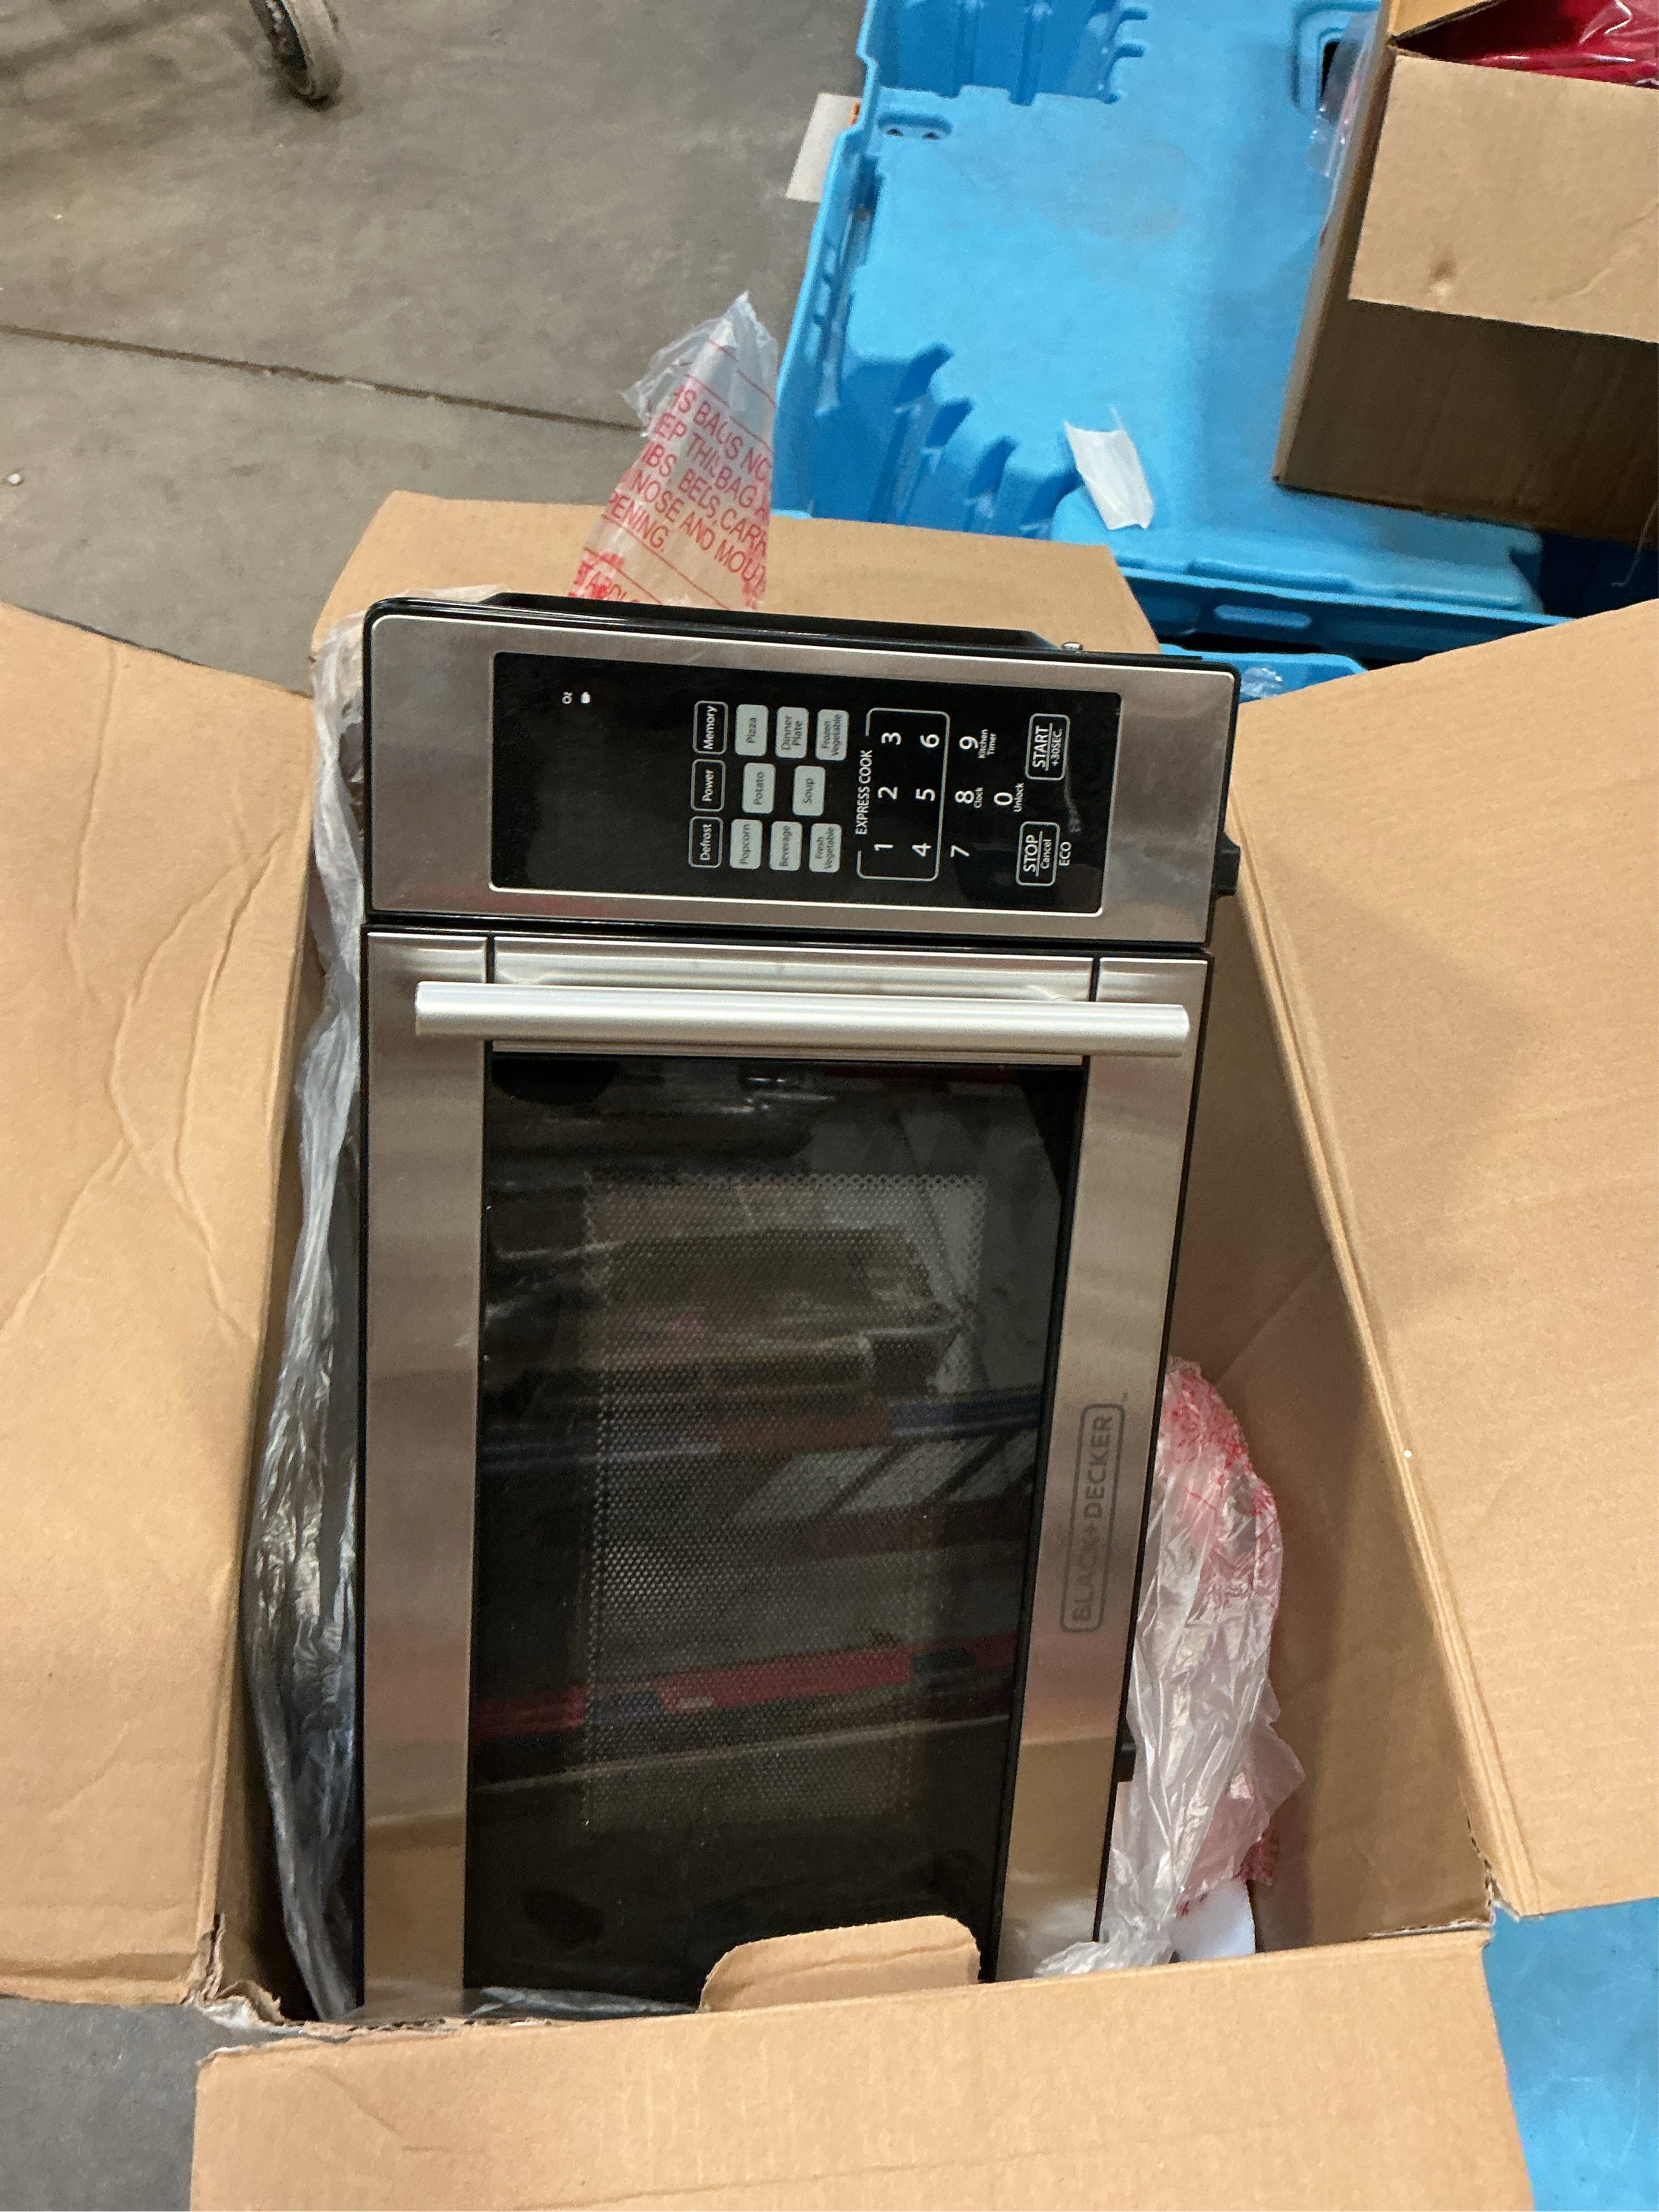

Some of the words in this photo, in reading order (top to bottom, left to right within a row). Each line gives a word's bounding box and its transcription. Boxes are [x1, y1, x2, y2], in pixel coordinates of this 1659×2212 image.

[714, 466, 758, 508] BAG
[630, 469, 684, 523] NOSE
[678, 511, 716, 551] AND
[703, 705, 719, 750] Memory
[745, 717, 758, 744] Pizza
[781, 714, 792, 750] Dinner
[792, 720, 804, 746] Plate
[821, 720, 831, 749] Frozen
[830, 714, 842, 756] Vegetable
[881, 732, 903, 745] 3
[920, 734, 940, 749] 6
[959, 736, 979, 750] 9
[978, 728, 989, 759] Kitchen
[987, 732, 997, 756] Timer
[1032, 725, 1050, 769] START
[858, 749, 873, 784] COOK
[702, 769, 715, 802] Power
[753, 771, 765, 805] Potato
[802, 777, 815, 805] Soup
[877, 786, 898, 800] 2
[915, 788, 936, 802] 5
[954, 790, 975, 805] 8
[973, 786, 984, 809] Clock
[993, 792, 1014, 806] 0
[1013, 782, 1025, 813] Unlock
[854, 786, 871, 835] EXPRESS
[699, 823, 712, 861] Defrost
[739, 823, 751, 864] Popcorn
[778, 825, 792, 867] Beverage
[814, 836, 825, 859] Fresh
[825, 826, 836, 869] Vegetable
[873, 843, 893, 852] 1
[911, 842, 932, 858] 4
[950, 845, 970, 858] 7
[1023, 834, 1039, 873] STOP
[1040, 839, 1052, 869] Cancel
[1058, 841, 1072, 867] ECO
